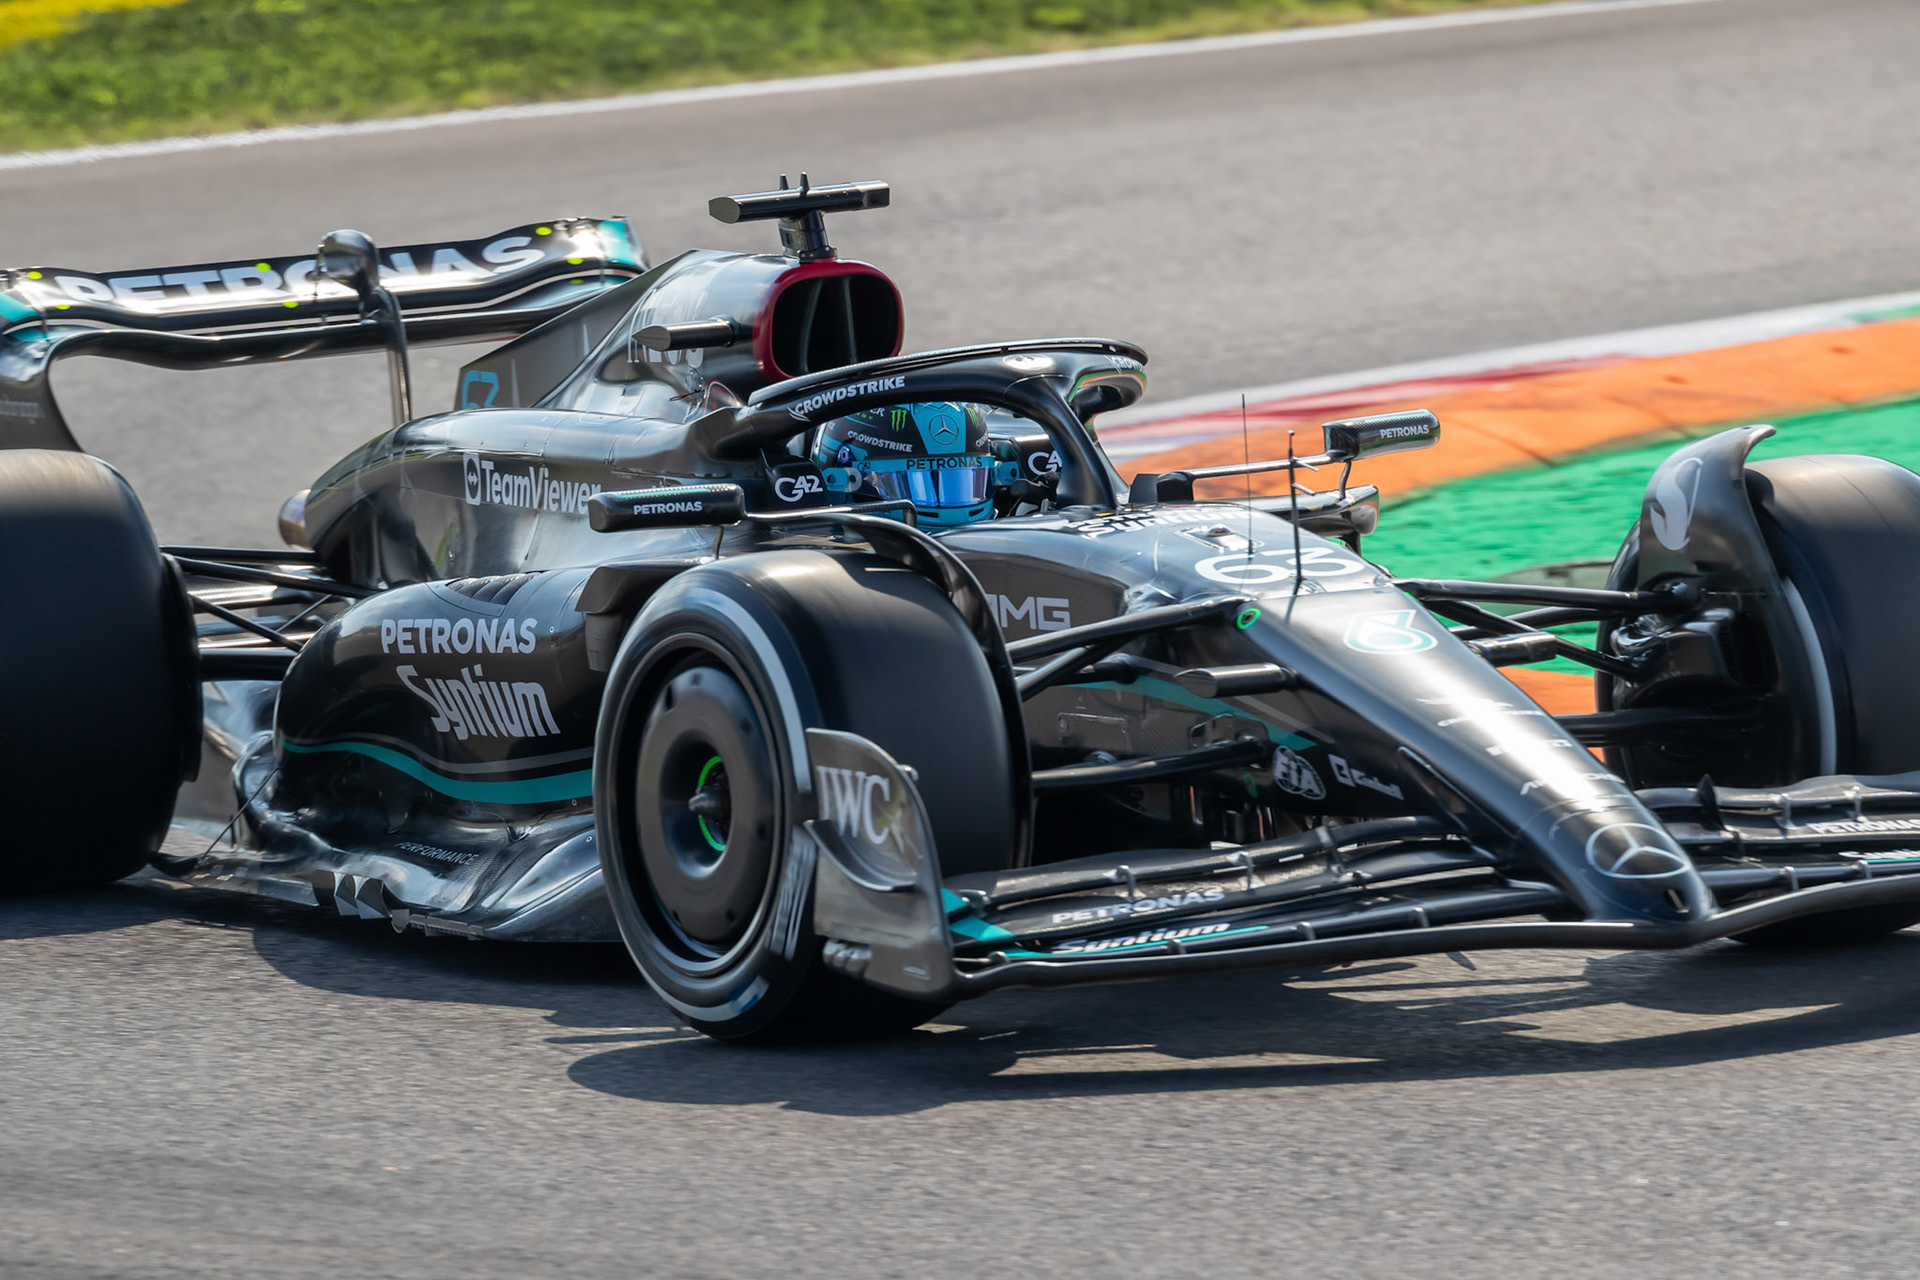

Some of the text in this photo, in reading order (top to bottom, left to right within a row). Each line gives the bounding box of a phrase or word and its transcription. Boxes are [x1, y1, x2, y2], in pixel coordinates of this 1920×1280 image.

[794, 376, 906, 416] CROWDSTRIKE
[847, 430, 913, 453] CROWDSTRIKE
[1380, 425, 1430, 438] PETRONAS
[906, 456, 982, 471] PETRONAS
[775, 475, 823, 502] G42
[633, 501, 703, 515] PETRONAS
[1194, 548, 1365, 584] 63
[381, 617, 538, 654] PETRONAS
[396, 664, 560, 741] Syntium
[816, 765, 891, 845] IWC
[394, 841, 479, 865] PERFORMANCE
[1051, 887, 1225, 924] PETRONAS
